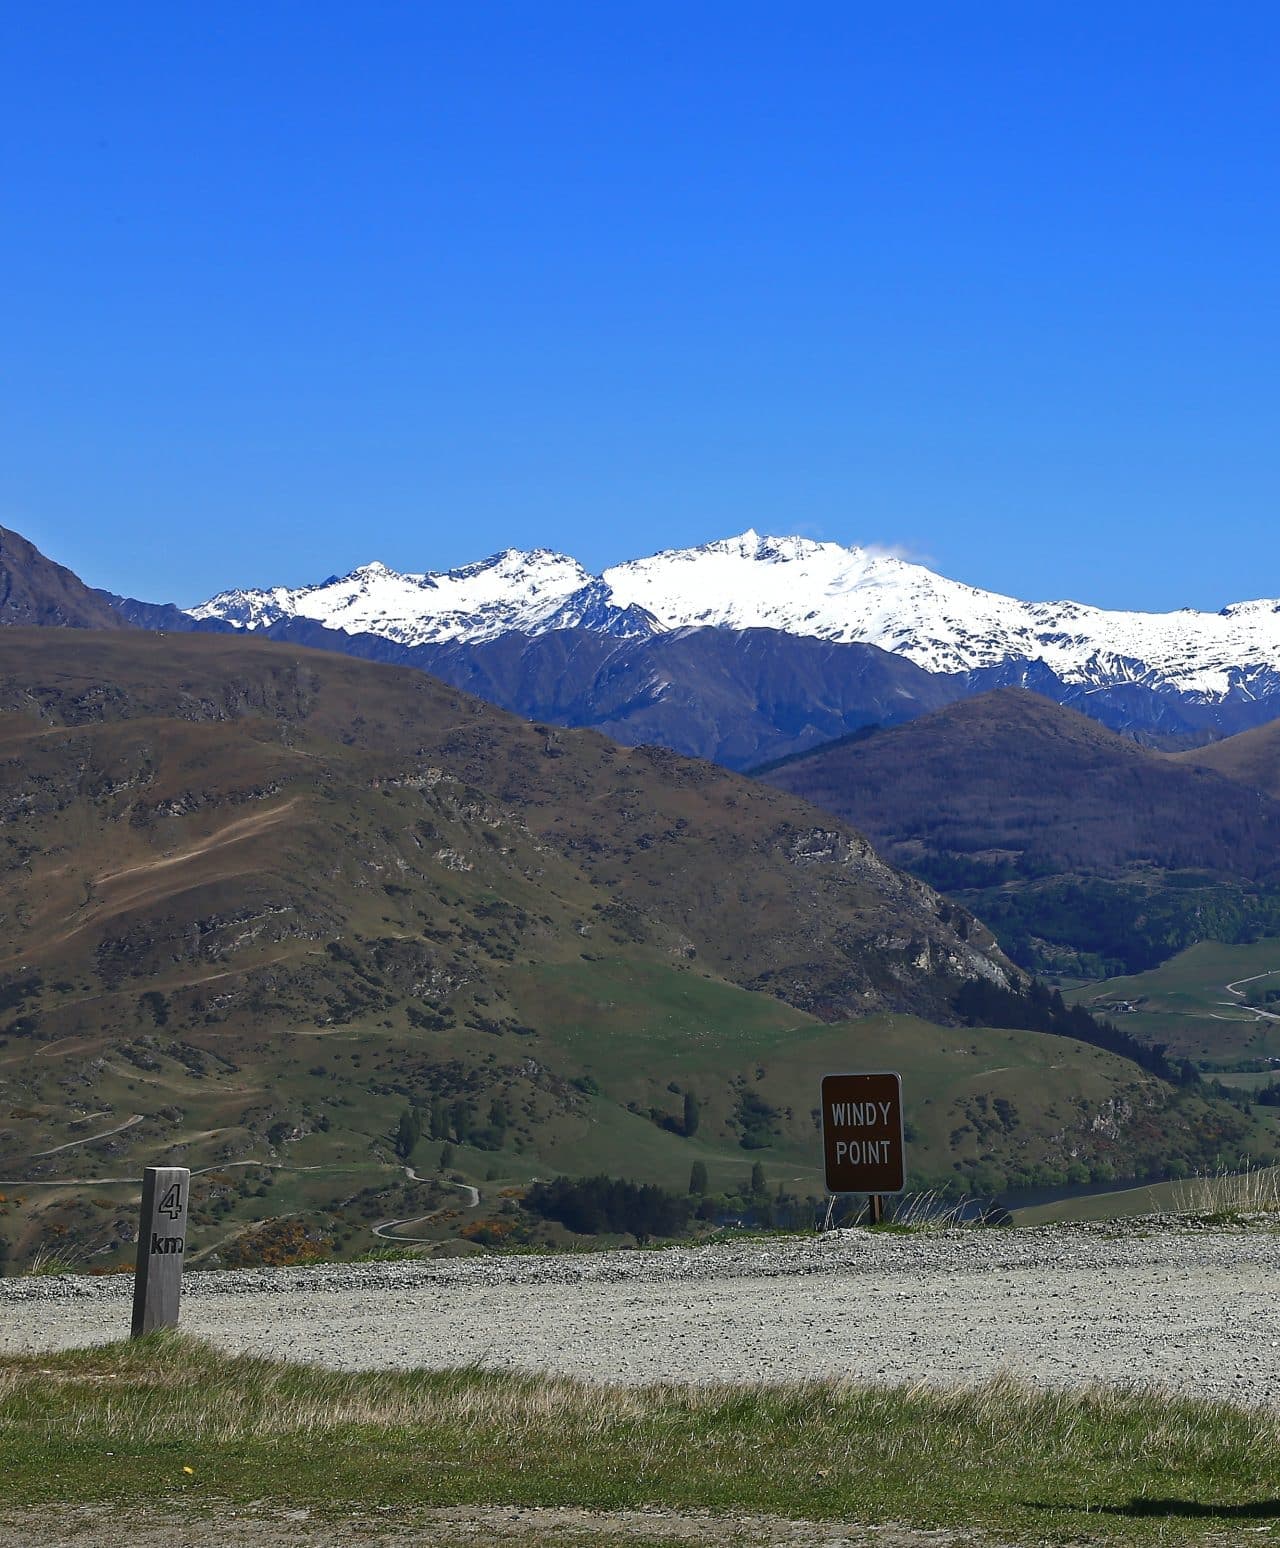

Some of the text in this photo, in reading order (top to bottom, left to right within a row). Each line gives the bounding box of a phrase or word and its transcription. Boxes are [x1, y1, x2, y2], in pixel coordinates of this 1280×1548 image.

[831, 1102, 891, 1126] WINDY
[836, 1141, 890, 1164] POINT
[158, 1183, 182, 1220] 4
[151, 1233, 183, 1254] km
